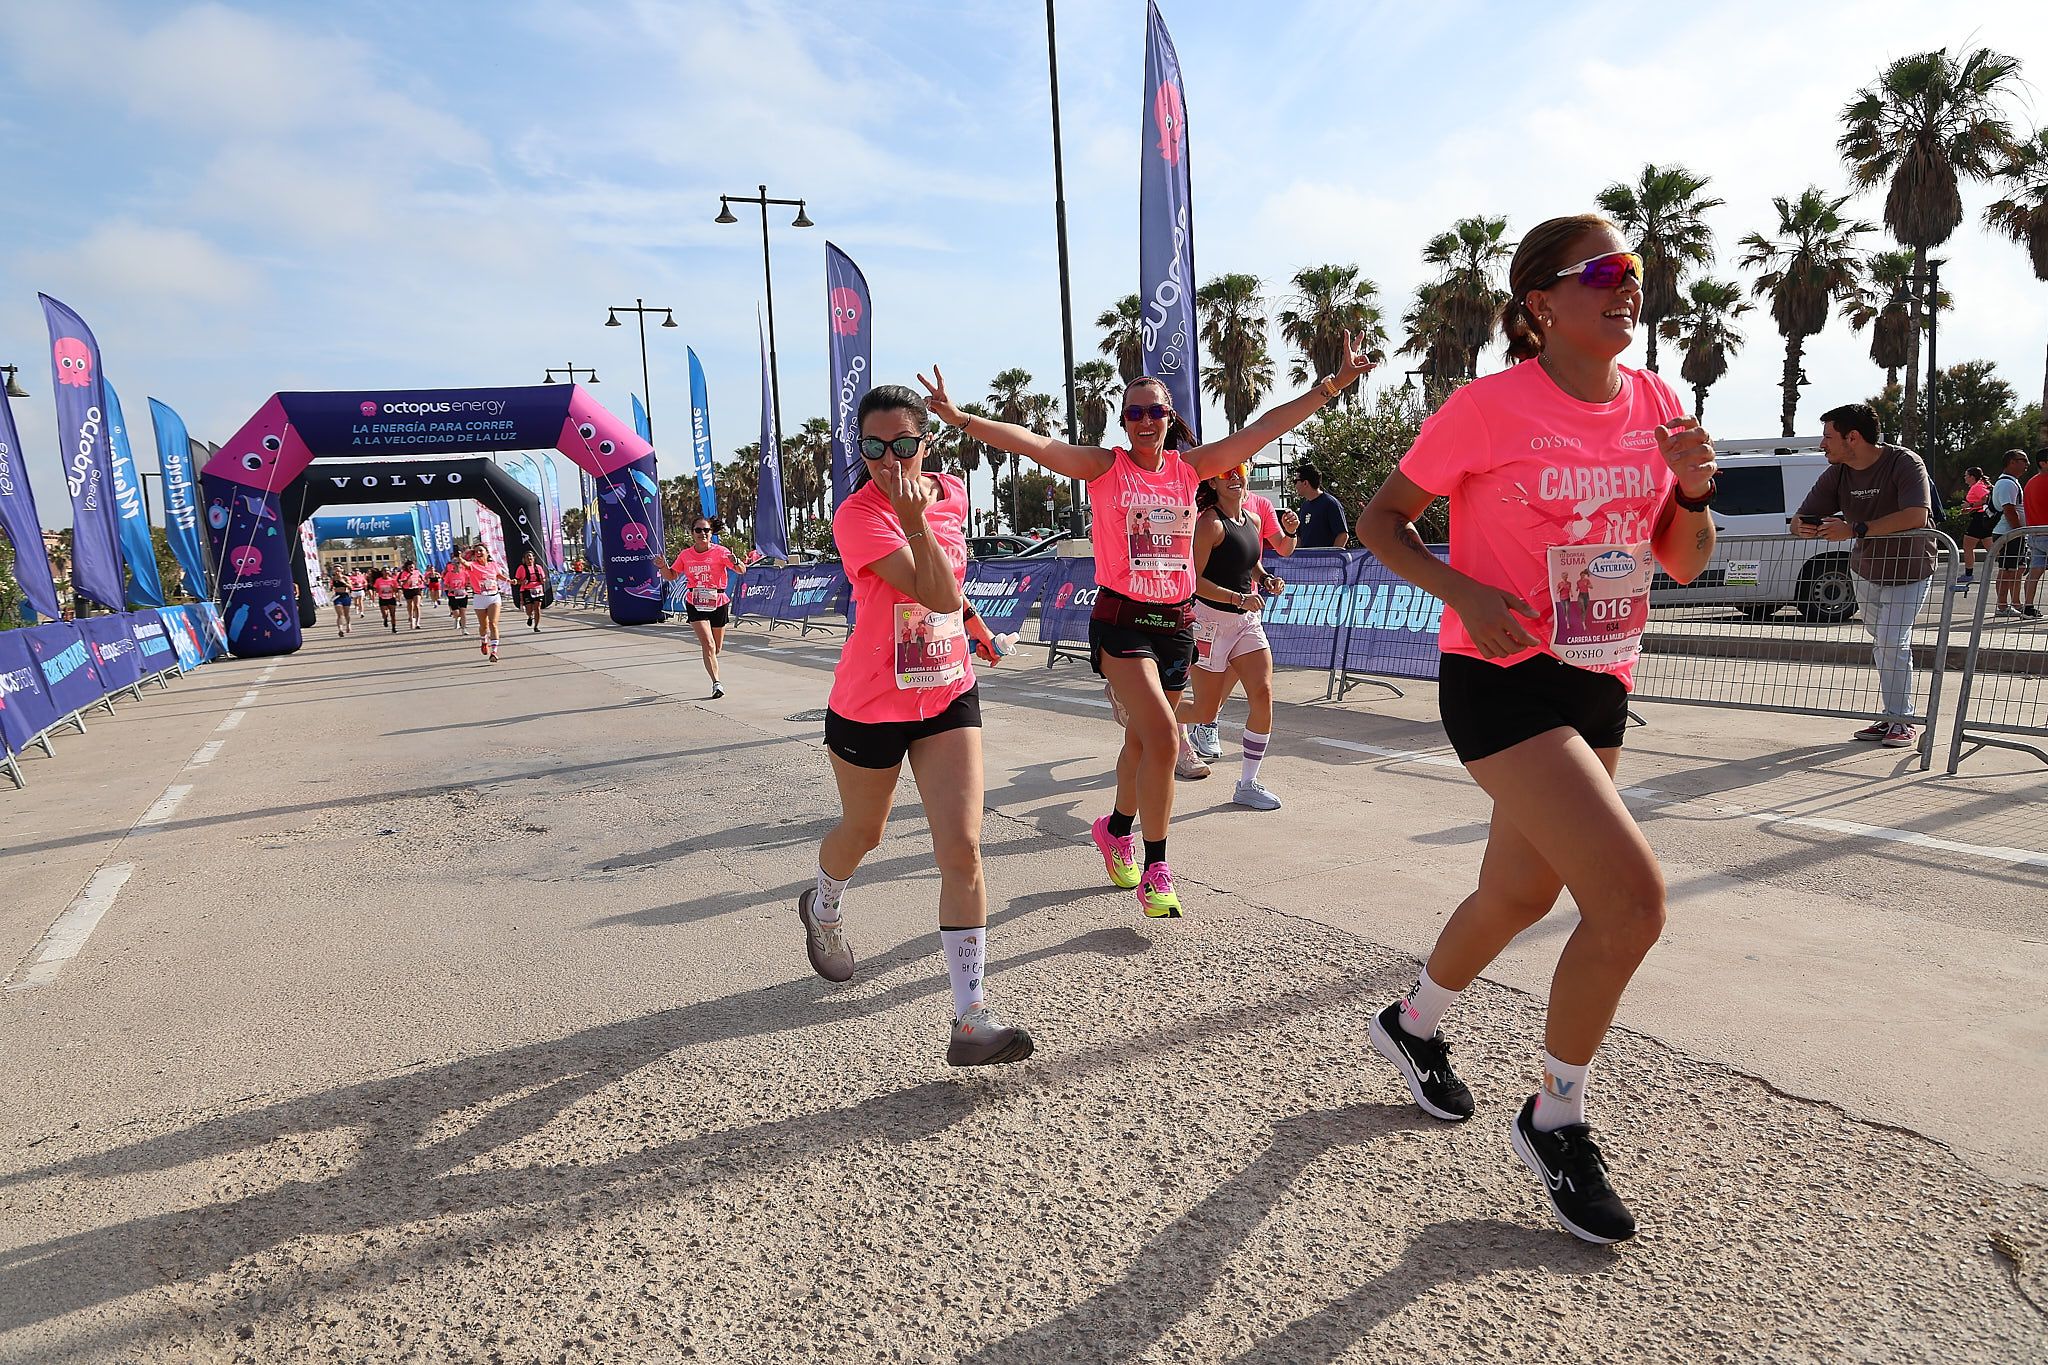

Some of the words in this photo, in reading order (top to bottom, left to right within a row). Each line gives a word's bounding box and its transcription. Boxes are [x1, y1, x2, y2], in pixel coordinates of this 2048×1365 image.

[383, 401, 450, 416] octopus
[451, 400, 506, 416] energy
[352, 424, 369, 434] LA
[372, 421, 426, 433] ENERGÍA
[429, 422, 463, 432] PARA
[465, 420, 514, 431] CORRER
[352, 437, 361, 445] A
[364, 436, 381, 445] LA
[384, 434, 455, 444] VELOCIDAD
[457, 433, 473, 442] DE
[476, 432, 491, 442] LA
[494, 431, 517, 441] LUZ
[1622, 437, 1658, 448] ASTURIAN
[329, 472, 463, 488] VOLVO
[1539, 463, 1656, 501] CARRERA
[346, 516, 391, 535] Marlene
[1152, 534, 1173, 546] 016
[611, 555, 640, 564] octopus
[1560, 557, 1586, 566] SUMA
[1592, 561, 1633, 573] ASTURIANA
[1129, 576, 1179, 599] MUJER
[1592, 598, 1632, 620] 016
[1606, 622, 1619, 632] 634
[1567, 636, 1593, 644] CARRERA
[927, 639, 952, 656] 016
[1565, 648, 1604, 659] OYSHO
